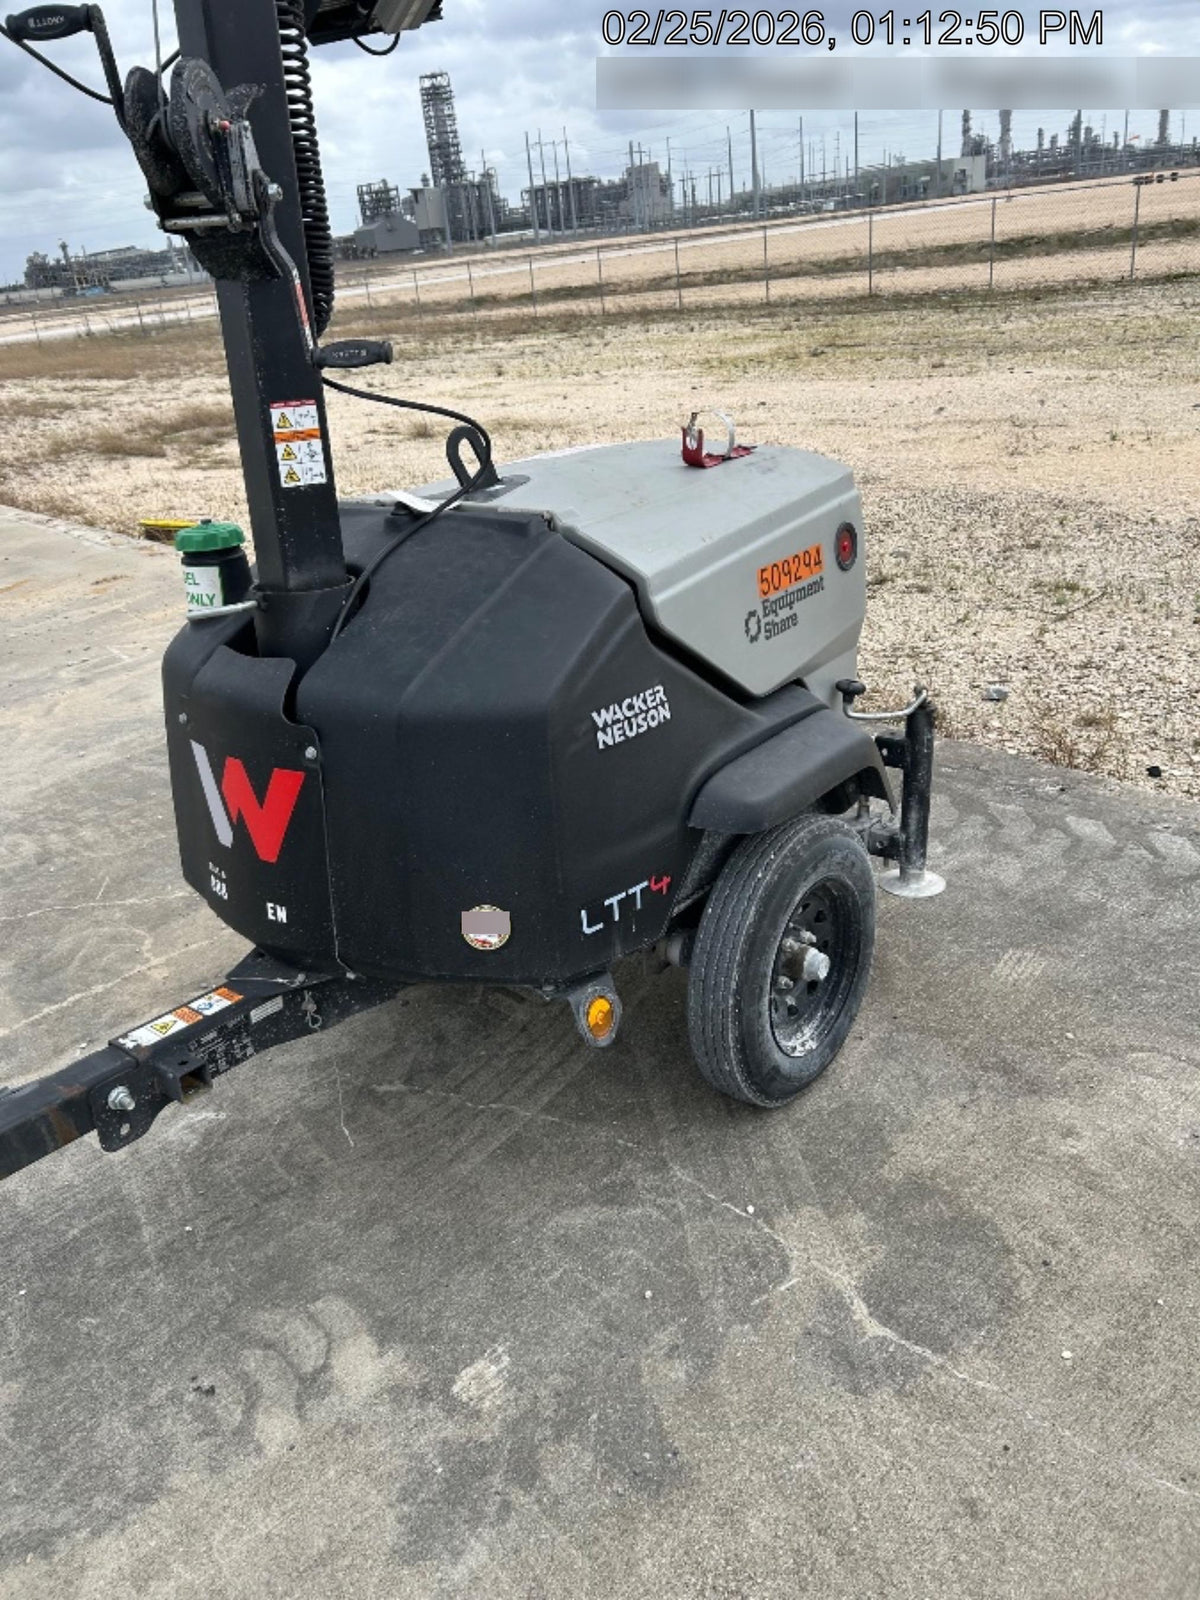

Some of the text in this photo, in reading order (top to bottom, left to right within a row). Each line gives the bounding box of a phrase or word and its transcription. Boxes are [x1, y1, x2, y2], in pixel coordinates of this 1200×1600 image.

[760, 546, 823, 596] 509294
[761, 576, 825, 619] Equipment
[764, 612, 799, 641] Share
[591, 684, 667, 728] WACKER
[597, 702, 671, 749] NEUSON
